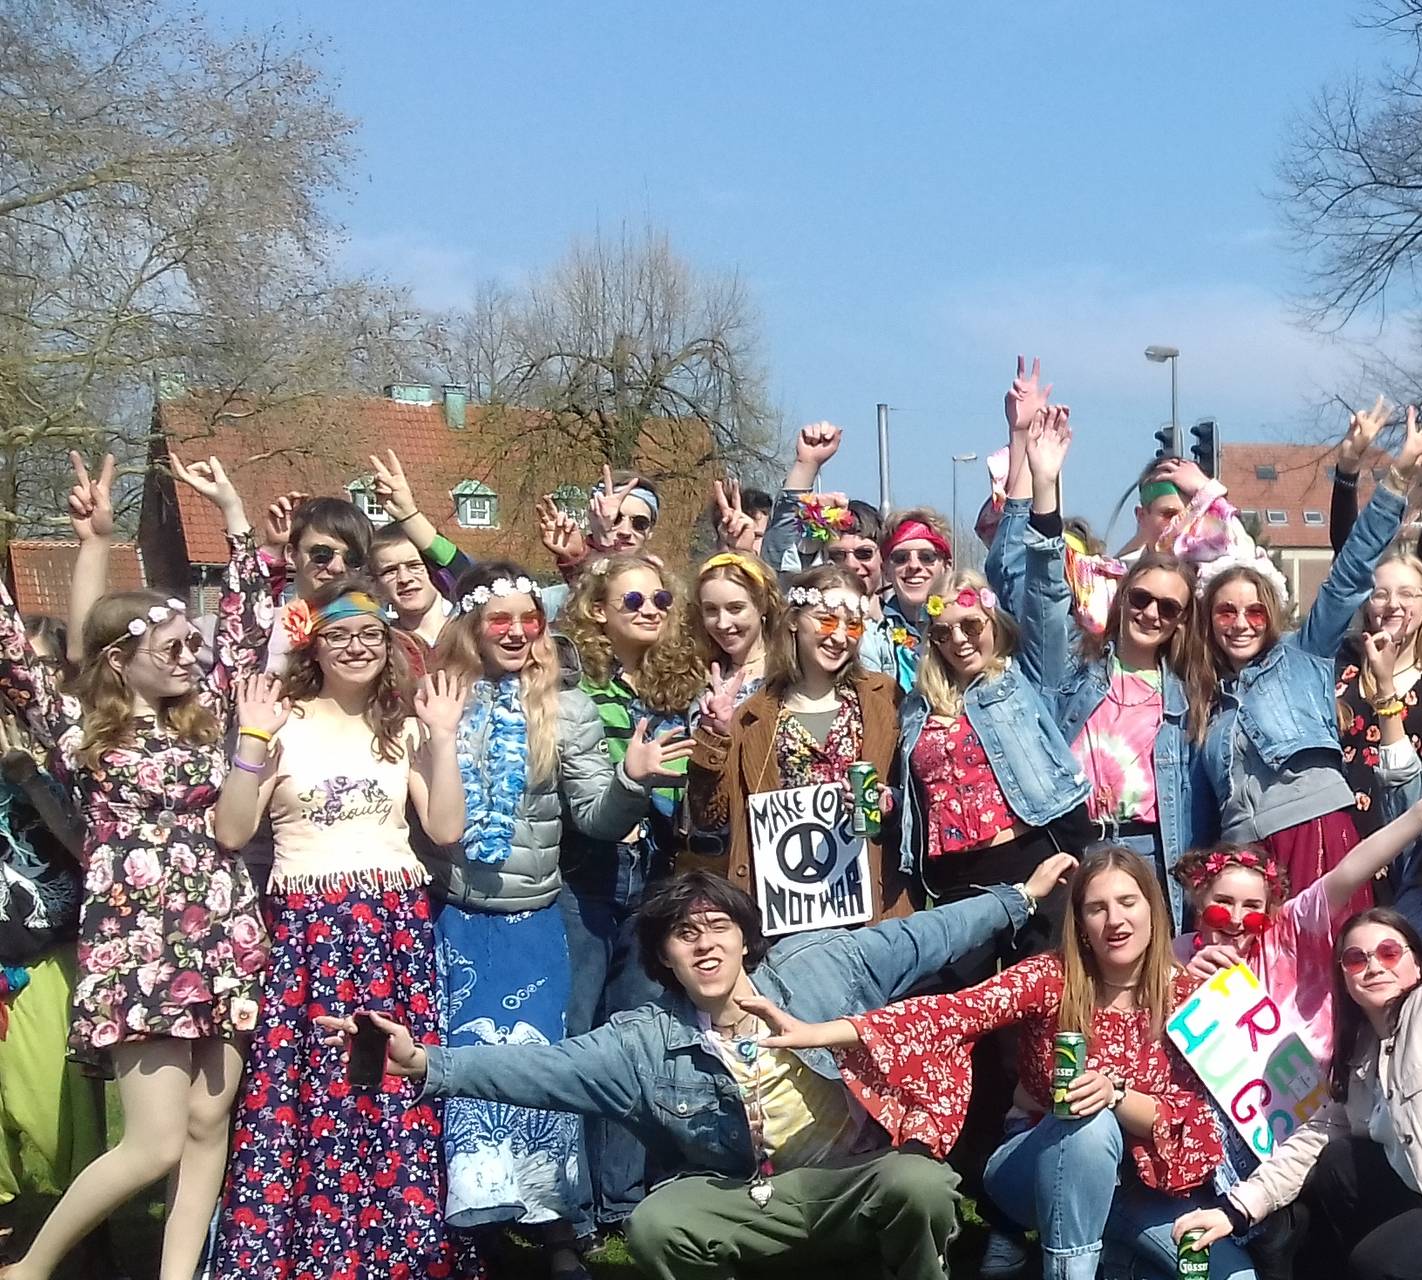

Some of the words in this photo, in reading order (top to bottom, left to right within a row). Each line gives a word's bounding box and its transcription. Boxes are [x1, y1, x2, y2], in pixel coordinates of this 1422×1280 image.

[751, 790, 806, 850] MAKE
[764, 876, 815, 930] NOT
[819, 856, 865, 918] WAR
[1167, 998, 1294, 1155] HUGS
